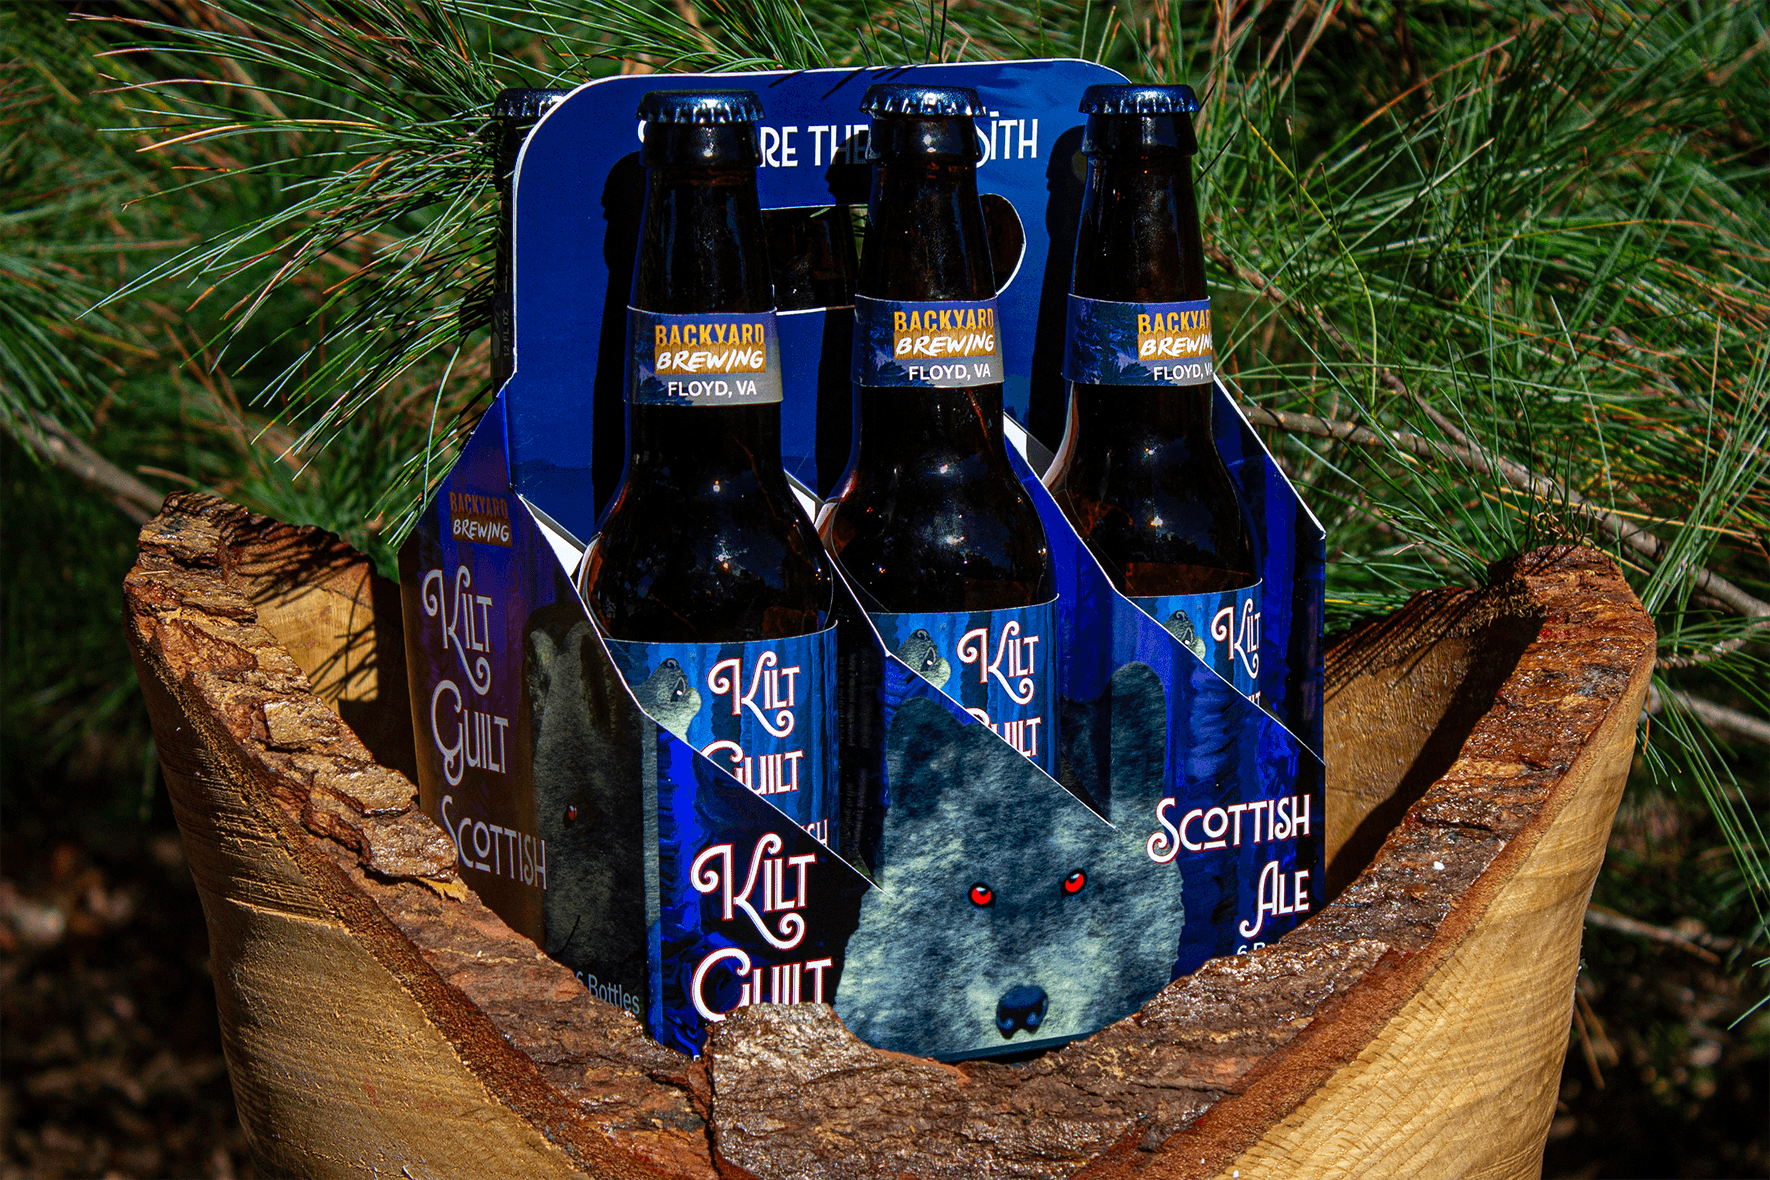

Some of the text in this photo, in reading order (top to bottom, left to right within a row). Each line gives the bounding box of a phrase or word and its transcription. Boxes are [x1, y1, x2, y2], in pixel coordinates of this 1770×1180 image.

[808, 124, 869, 166] THE
[655, 323, 765, 347] BACKYARD
[894, 308, 995, 332] BACKYARD
[657, 346, 764, 372] BREWING
[896, 331, 995, 357] BREWING
[668, 380, 757, 398] FLOYD, VA
[909, 362, 991, 381] FLOYD, VA
[1153, 364, 1204, 381] FLOYD,
[449, 491, 508, 519] BACKYARD
[453, 519, 509, 542] BREWING
[422, 565, 493, 696] KILT
[1210, 598, 1261, 680] KILT
[956, 620, 1039, 706] KILT
[706, 650, 801, 739] KILT
[431, 679, 509, 786] GUILT
[1146, 793, 1311, 865] SCOTTISH
[689, 832, 817, 951] KILT
[1238, 860, 1310, 939] ALE
[587, 973, 641, 1015] Bottles
